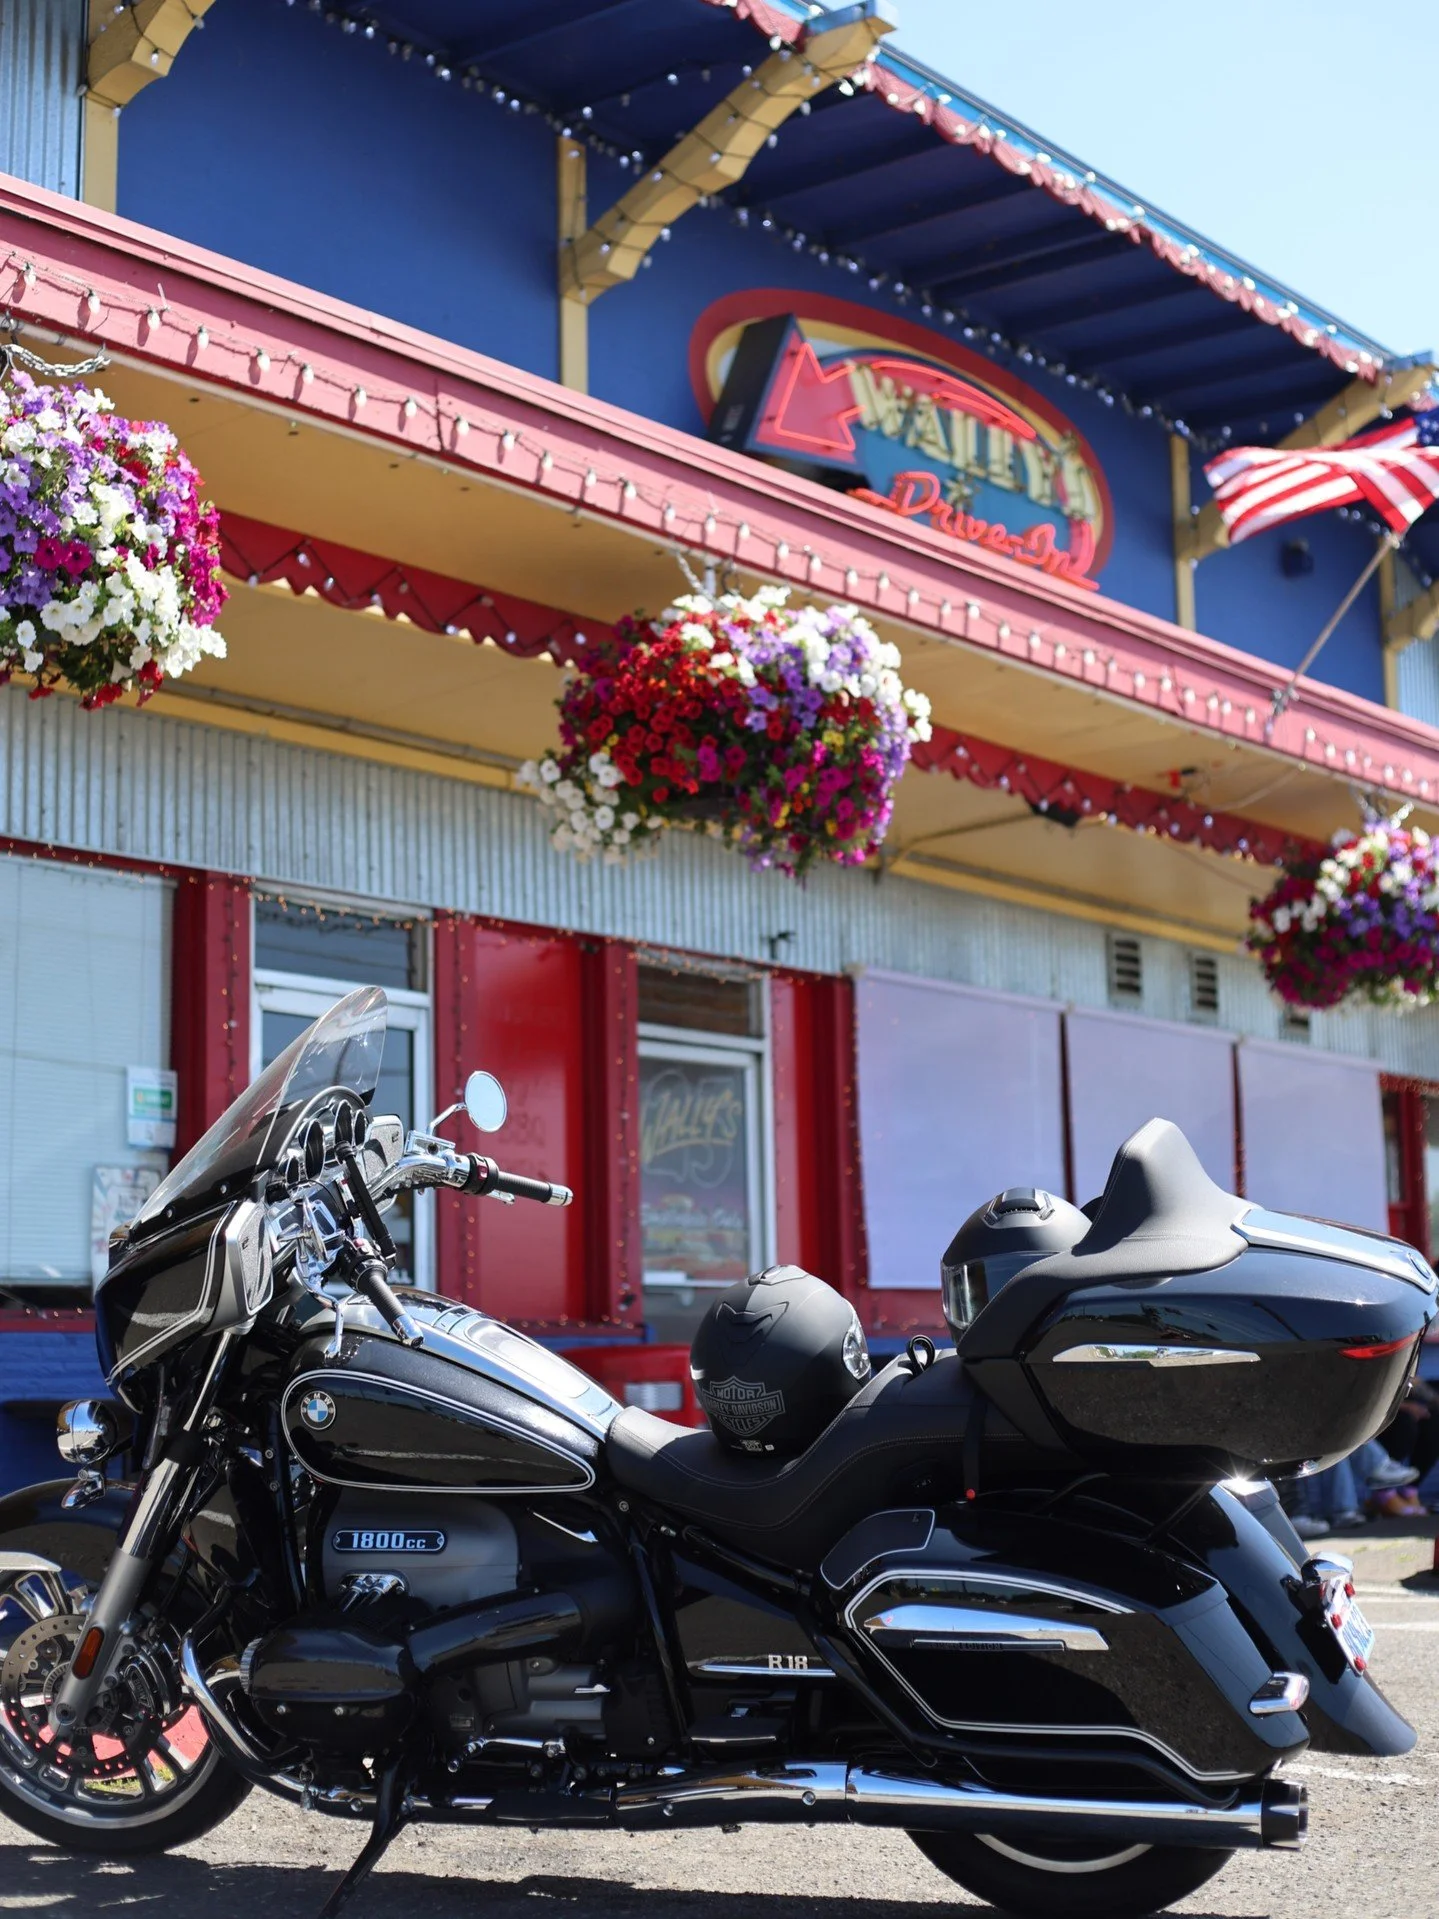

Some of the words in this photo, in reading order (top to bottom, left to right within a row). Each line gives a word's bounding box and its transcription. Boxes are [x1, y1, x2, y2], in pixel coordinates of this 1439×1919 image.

[303, 1392, 332, 1405] BMW
[717, 1385, 756, 1400] MOTOR
[352, 1532, 425, 1549] 1800cc
